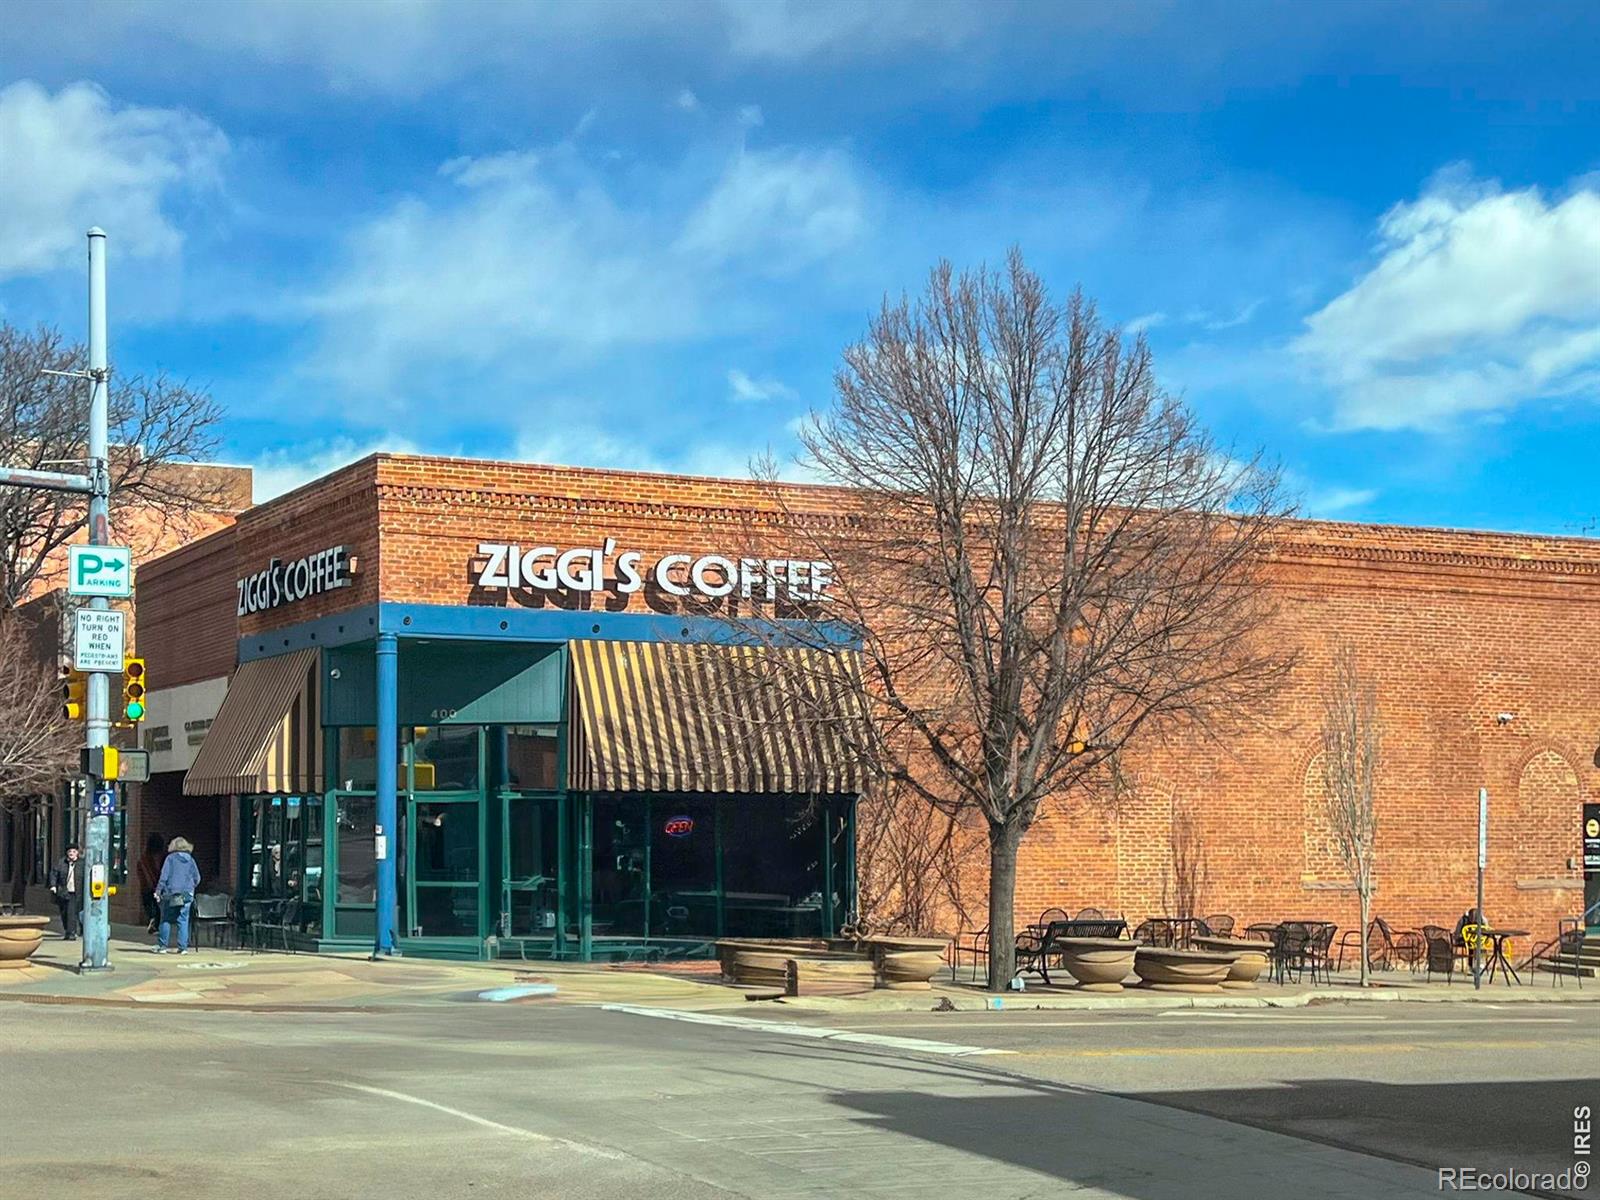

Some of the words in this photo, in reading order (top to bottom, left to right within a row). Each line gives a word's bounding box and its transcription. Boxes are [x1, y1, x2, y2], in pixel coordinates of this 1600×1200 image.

[479, 537, 642, 593] ZIGGI'S
[656, 554, 834, 601] COFFEE
[237, 557, 281, 616] ZIGGI'S
[284, 545, 343, 602] COFFEE
[80, 614, 92, 622] NO
[96, 615, 120, 623] RIGHT
[81, 623, 103, 631] TURN
[92, 633, 108, 641] RED
